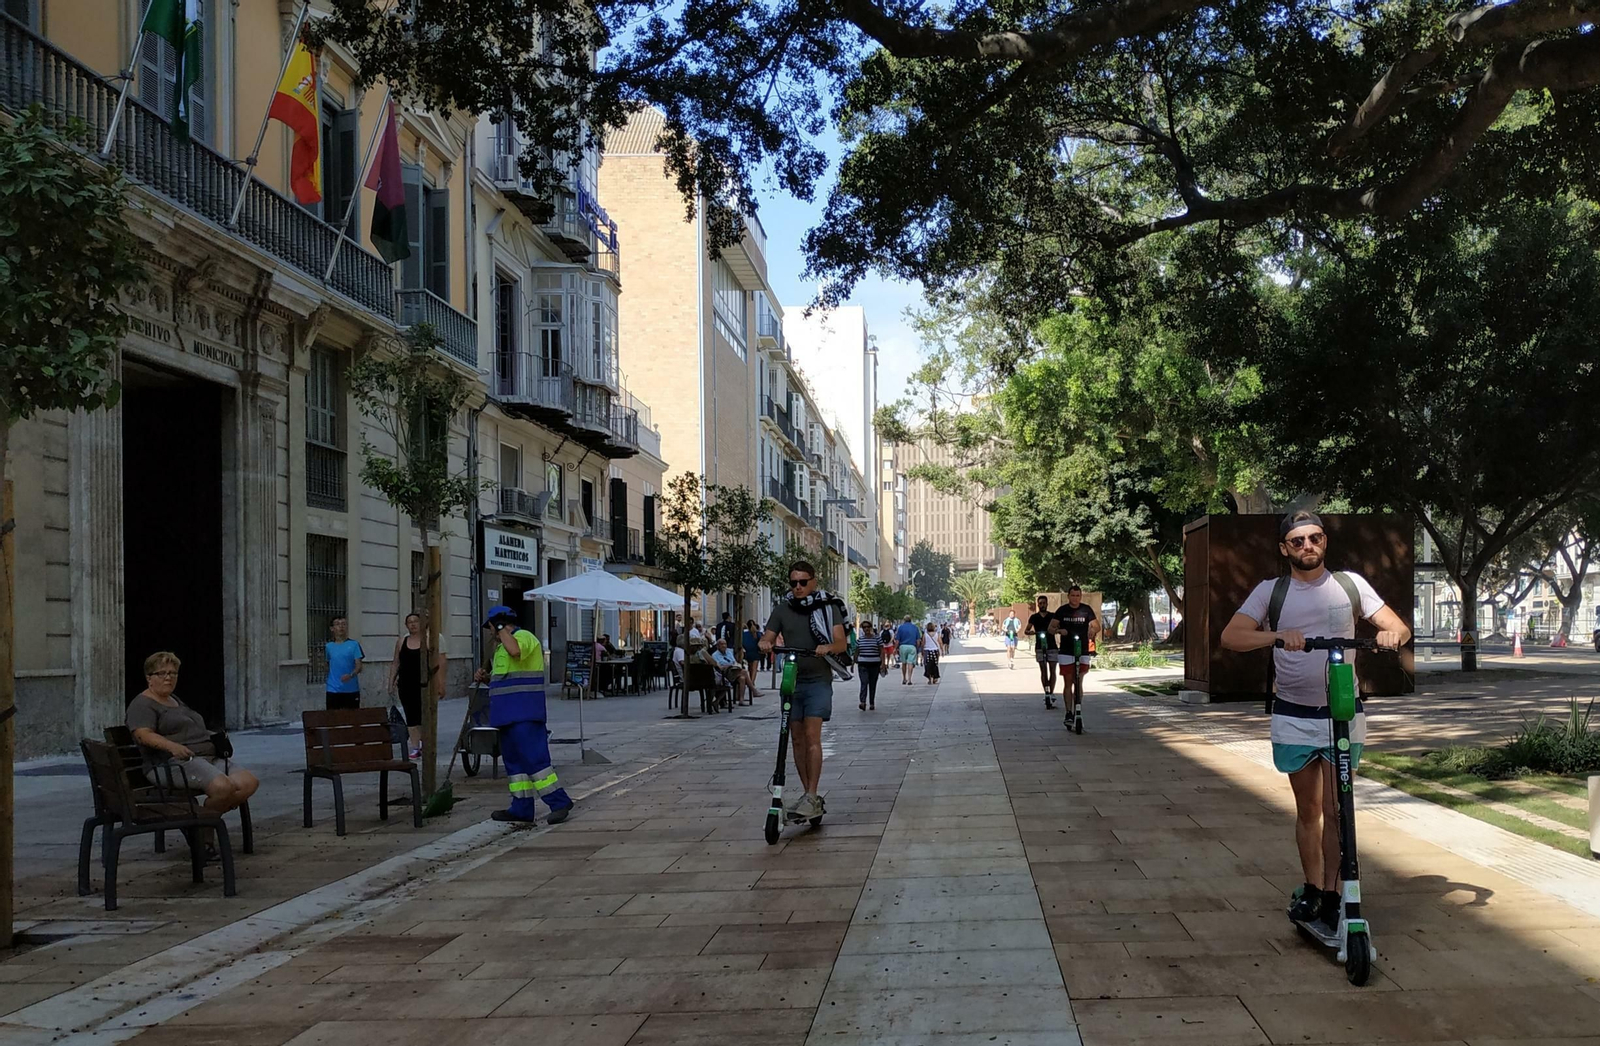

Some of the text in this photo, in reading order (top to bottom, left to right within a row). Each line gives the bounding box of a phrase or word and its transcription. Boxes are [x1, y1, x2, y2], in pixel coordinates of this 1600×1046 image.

[193, 340, 240, 368] MUNICIPAL
[498, 534, 525, 550] ALAMEDA
[494, 546, 529, 563] MARTIRICOS
